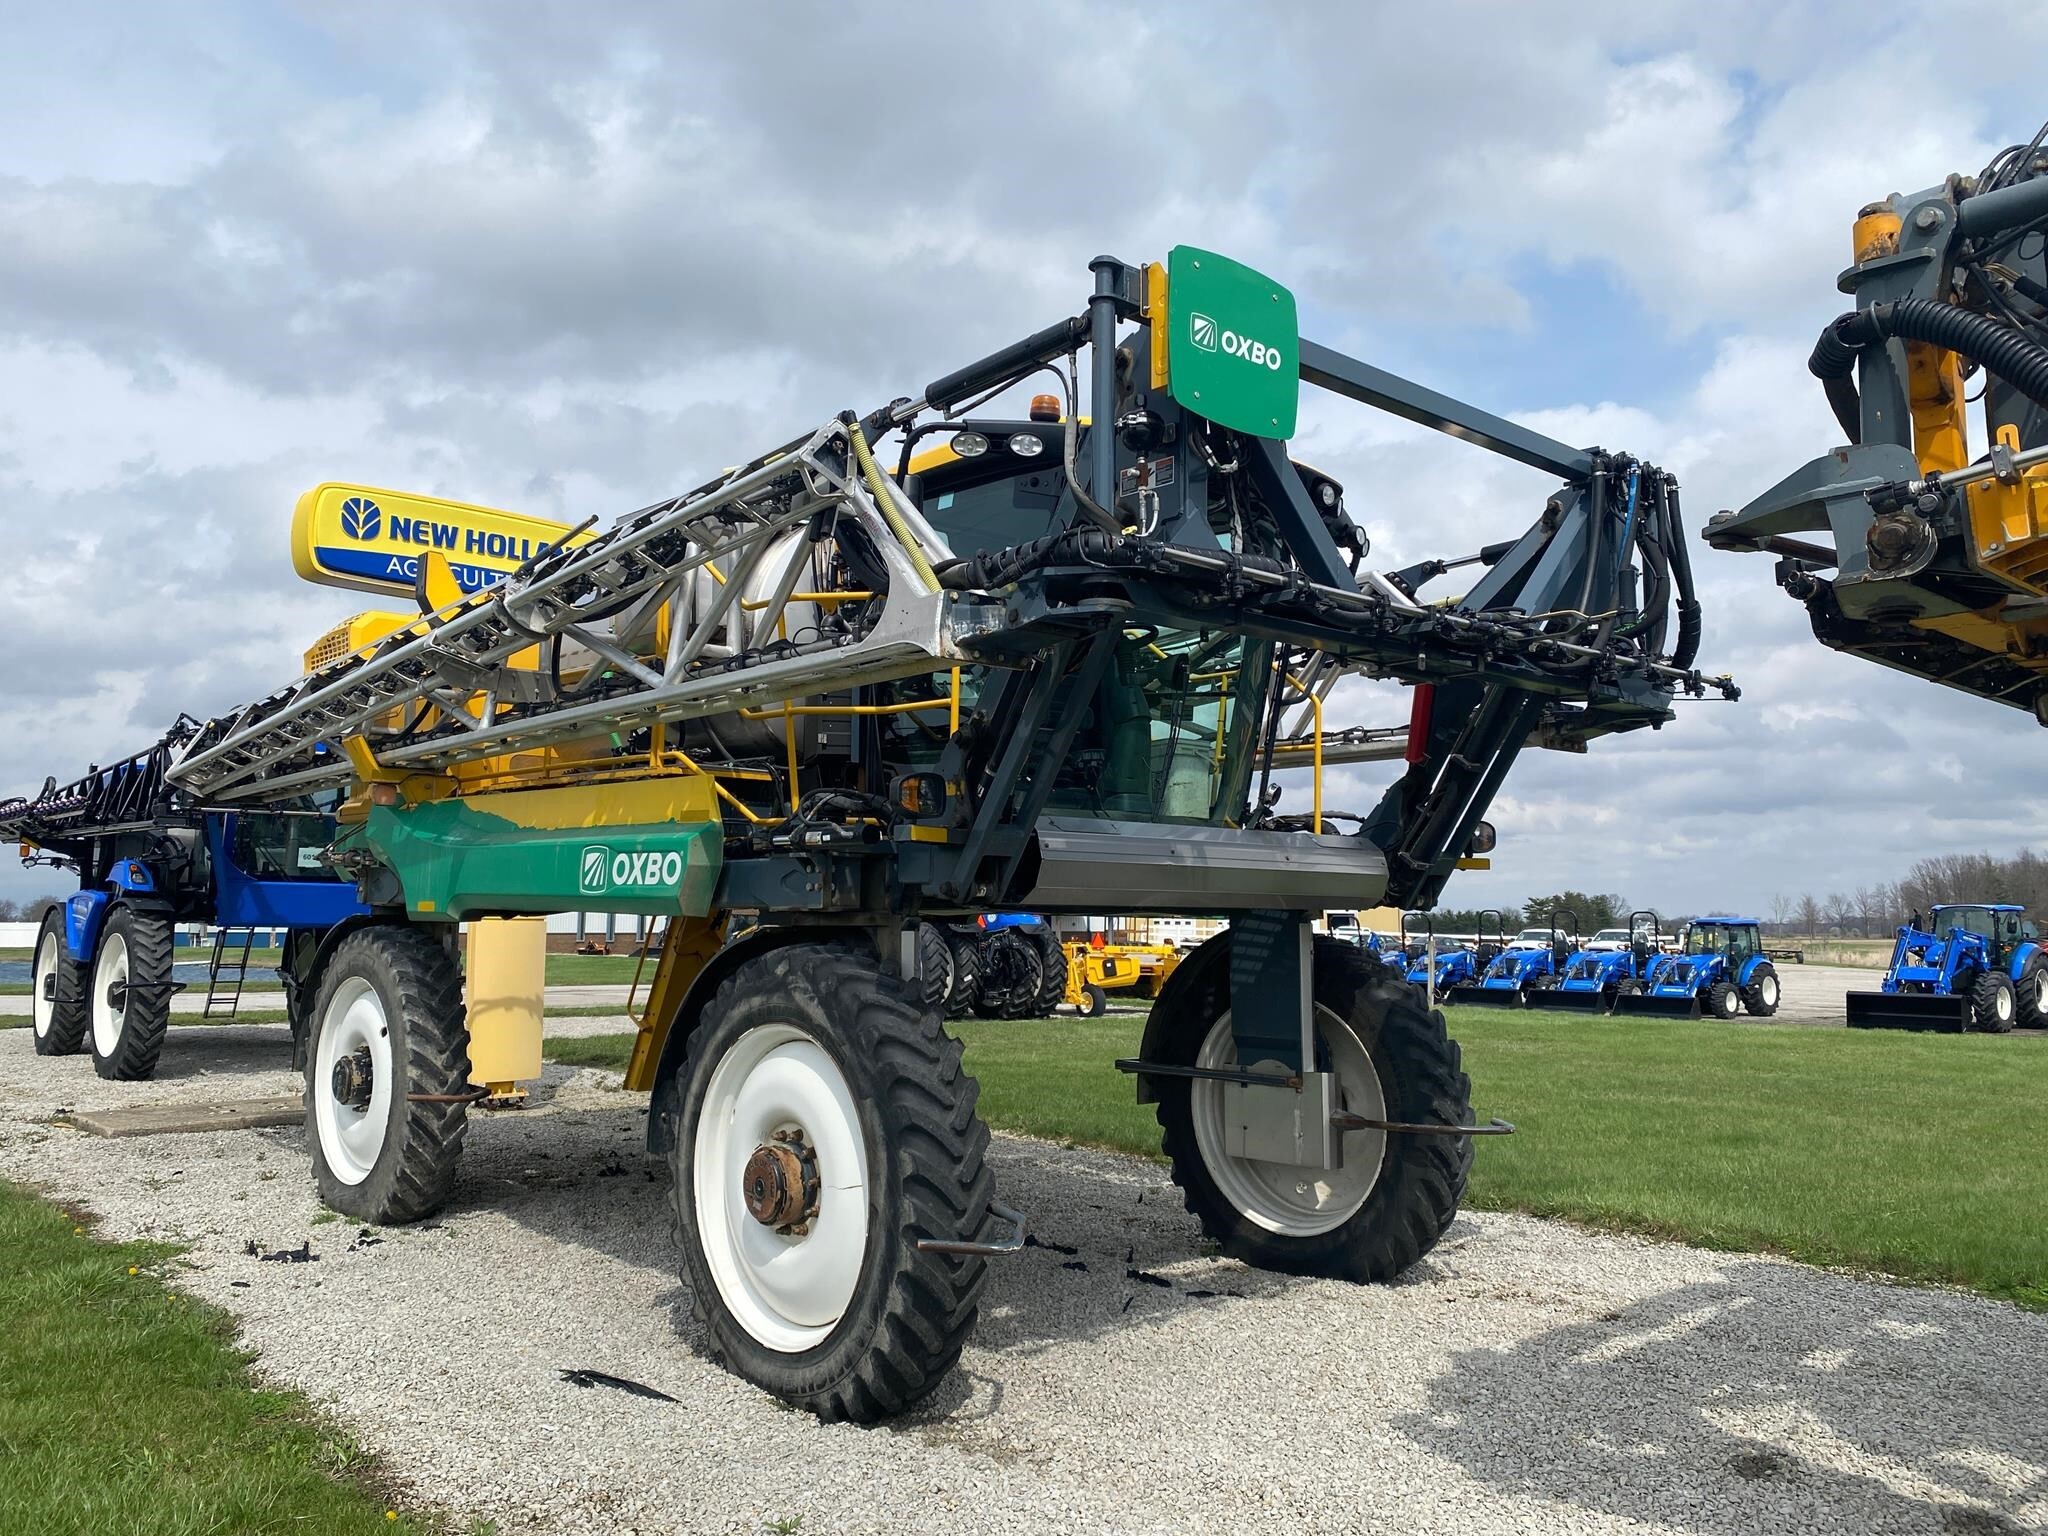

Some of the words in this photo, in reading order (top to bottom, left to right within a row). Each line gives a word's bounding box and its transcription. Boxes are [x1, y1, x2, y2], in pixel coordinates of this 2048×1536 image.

[1221, 330, 1281, 370] OXBO
[389, 515, 459, 551] NEW
[612, 851, 682, 886] OXBO
